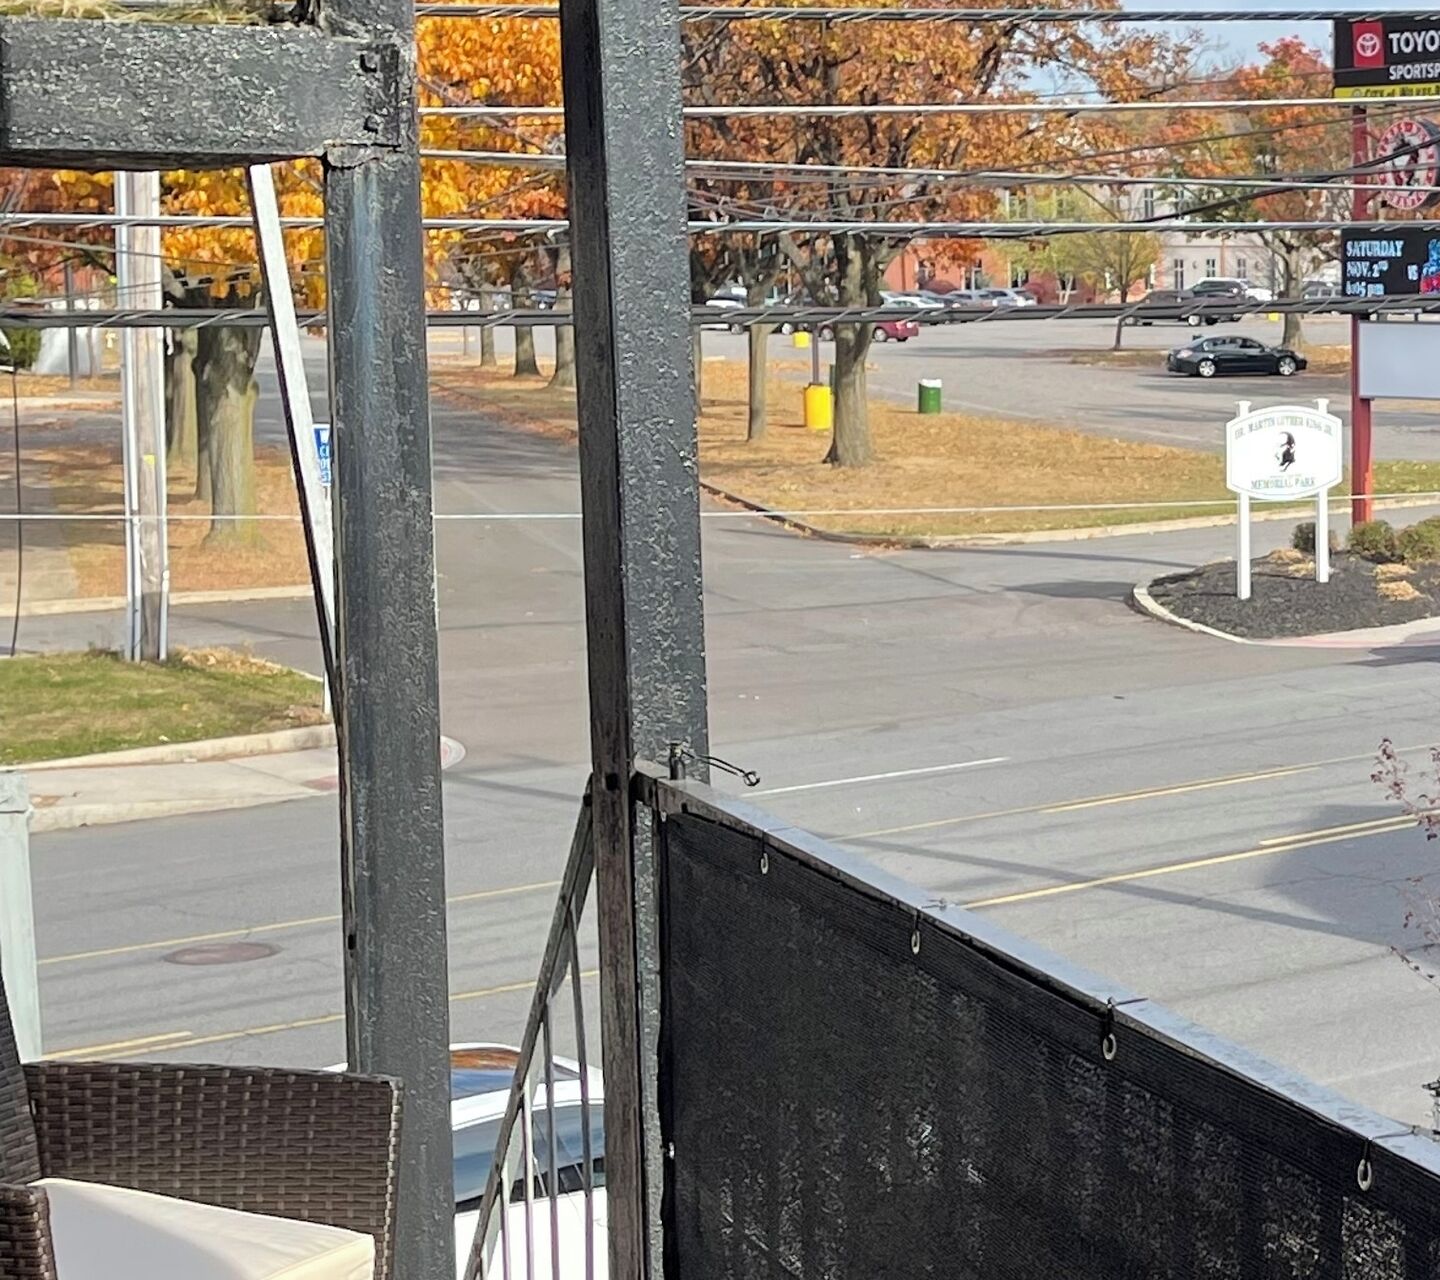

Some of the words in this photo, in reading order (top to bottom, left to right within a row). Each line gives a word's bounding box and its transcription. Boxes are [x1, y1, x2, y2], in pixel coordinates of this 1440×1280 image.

[1346, 240, 1404, 257] SATURDAY
[1346, 261, 1371, 277] NOV.
[1248, 417, 1276, 432] MARTIN
[1276, 416, 1304, 426] LUTHER
